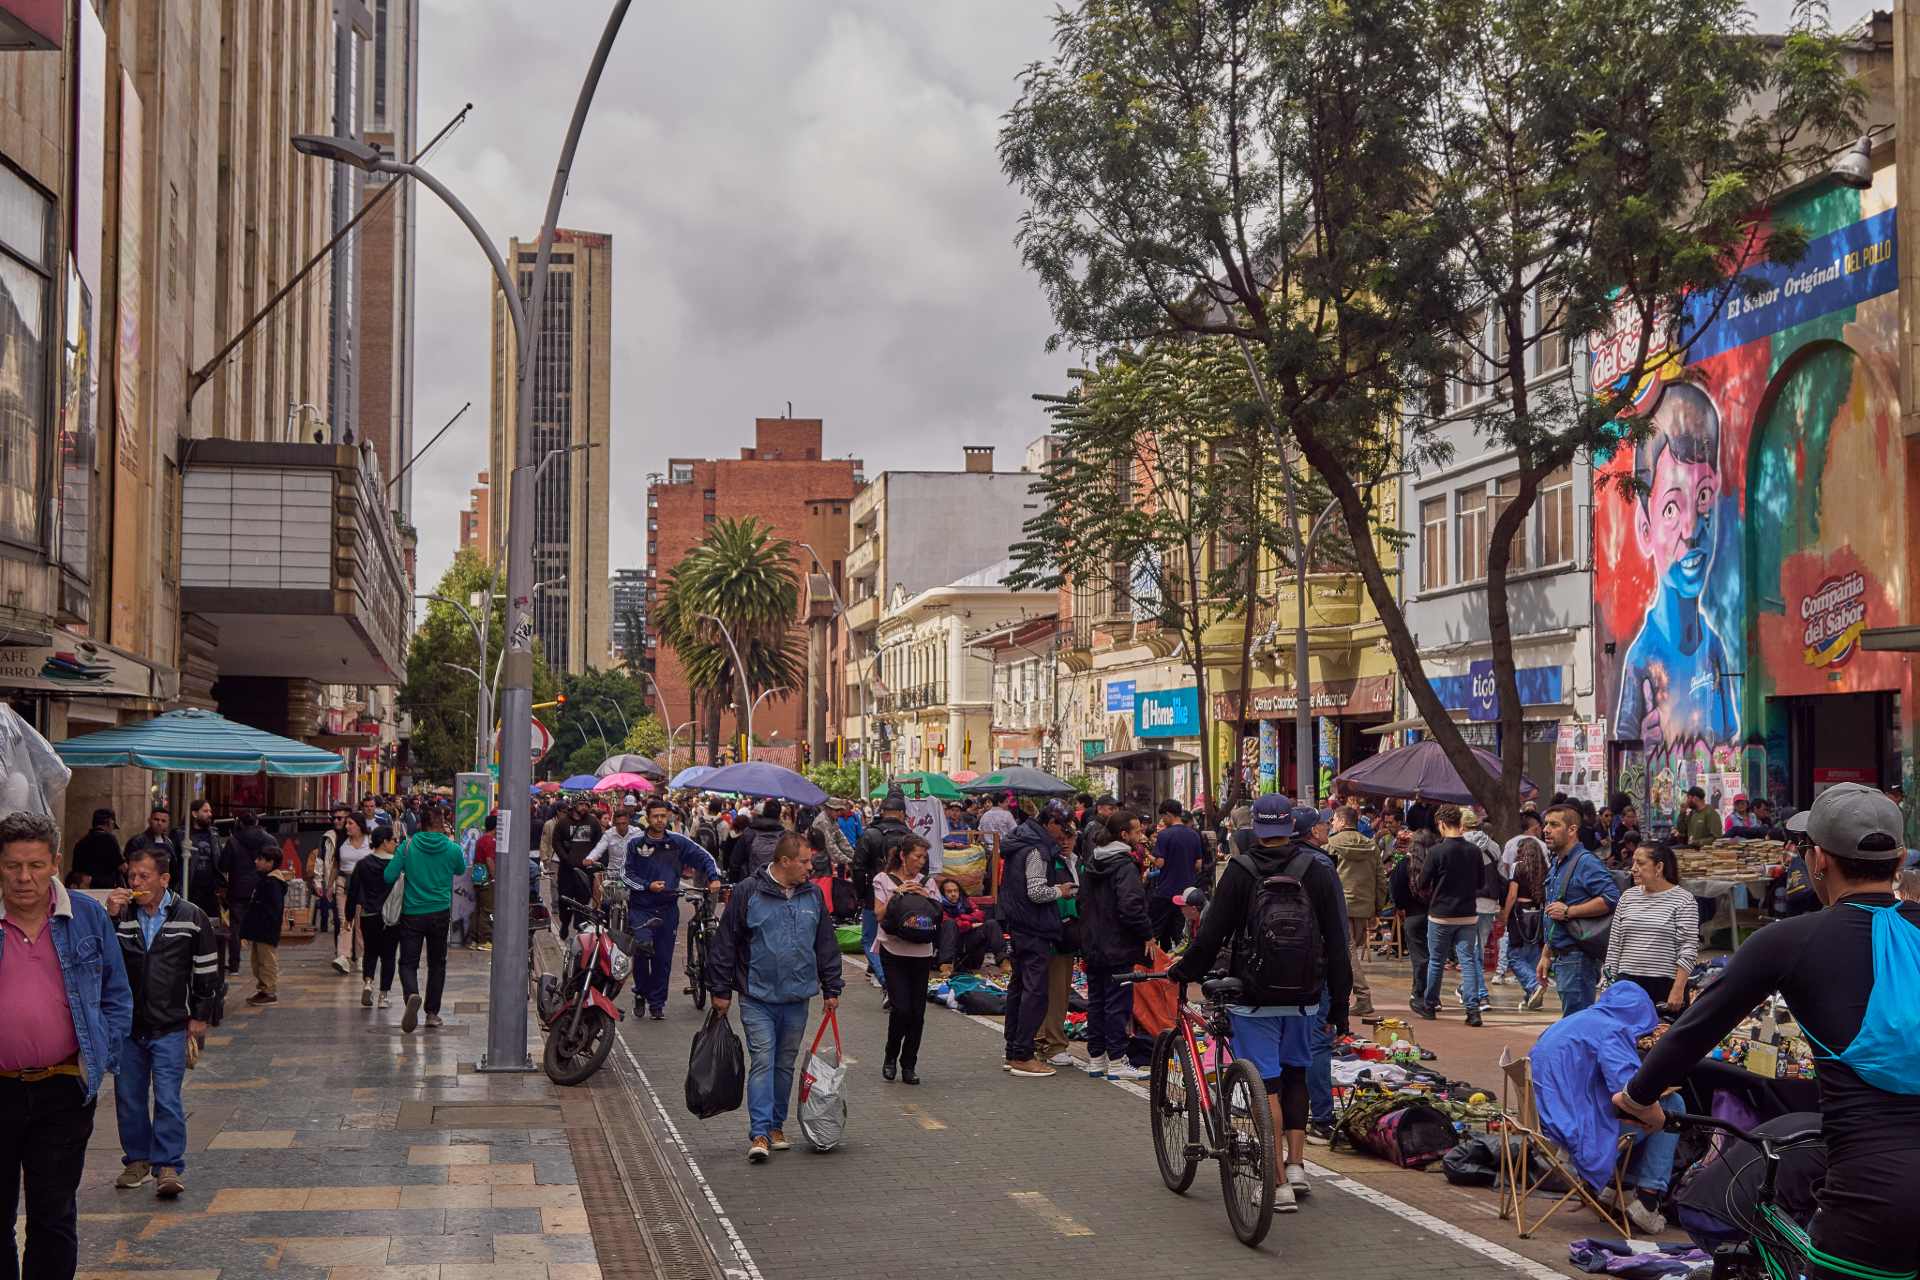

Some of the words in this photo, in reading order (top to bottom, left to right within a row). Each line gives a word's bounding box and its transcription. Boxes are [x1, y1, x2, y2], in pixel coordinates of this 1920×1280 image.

[1728, 298, 1740, 319] El
[1784, 258, 1841, 297] Original
[1844, 252, 1861, 275] DEL
[1863, 239, 1892, 268] POLLO
[1593, 341, 1618, 388] del
[1620, 316, 1668, 370] Saor
[1804, 617, 1824, 645] del
[1825, 603, 1865, 635] Sabor
